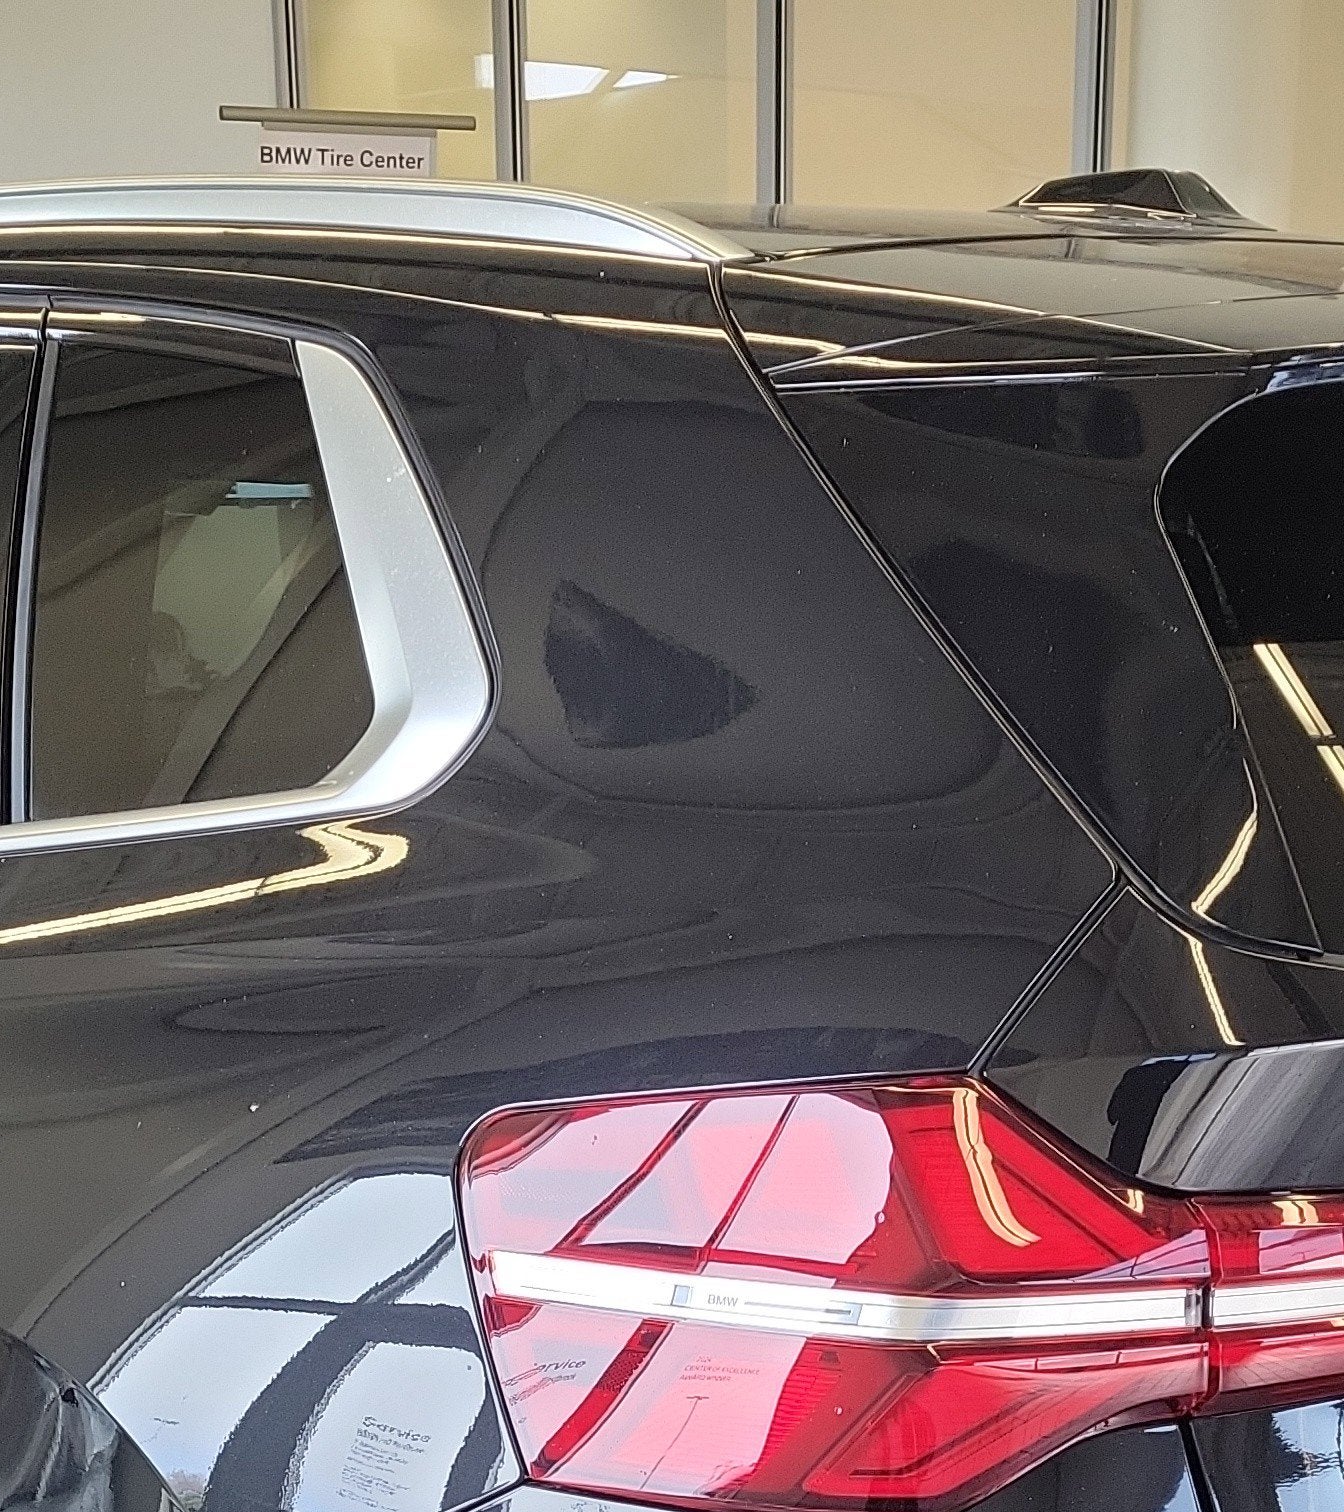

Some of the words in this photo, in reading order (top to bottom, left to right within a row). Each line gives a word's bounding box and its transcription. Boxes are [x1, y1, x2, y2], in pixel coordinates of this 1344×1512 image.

[260, 145, 312, 165] BMW
[316, 148, 354, 167] Tire
[360, 149, 425, 170] Center
[708, 1294, 739, 1307] BMW
